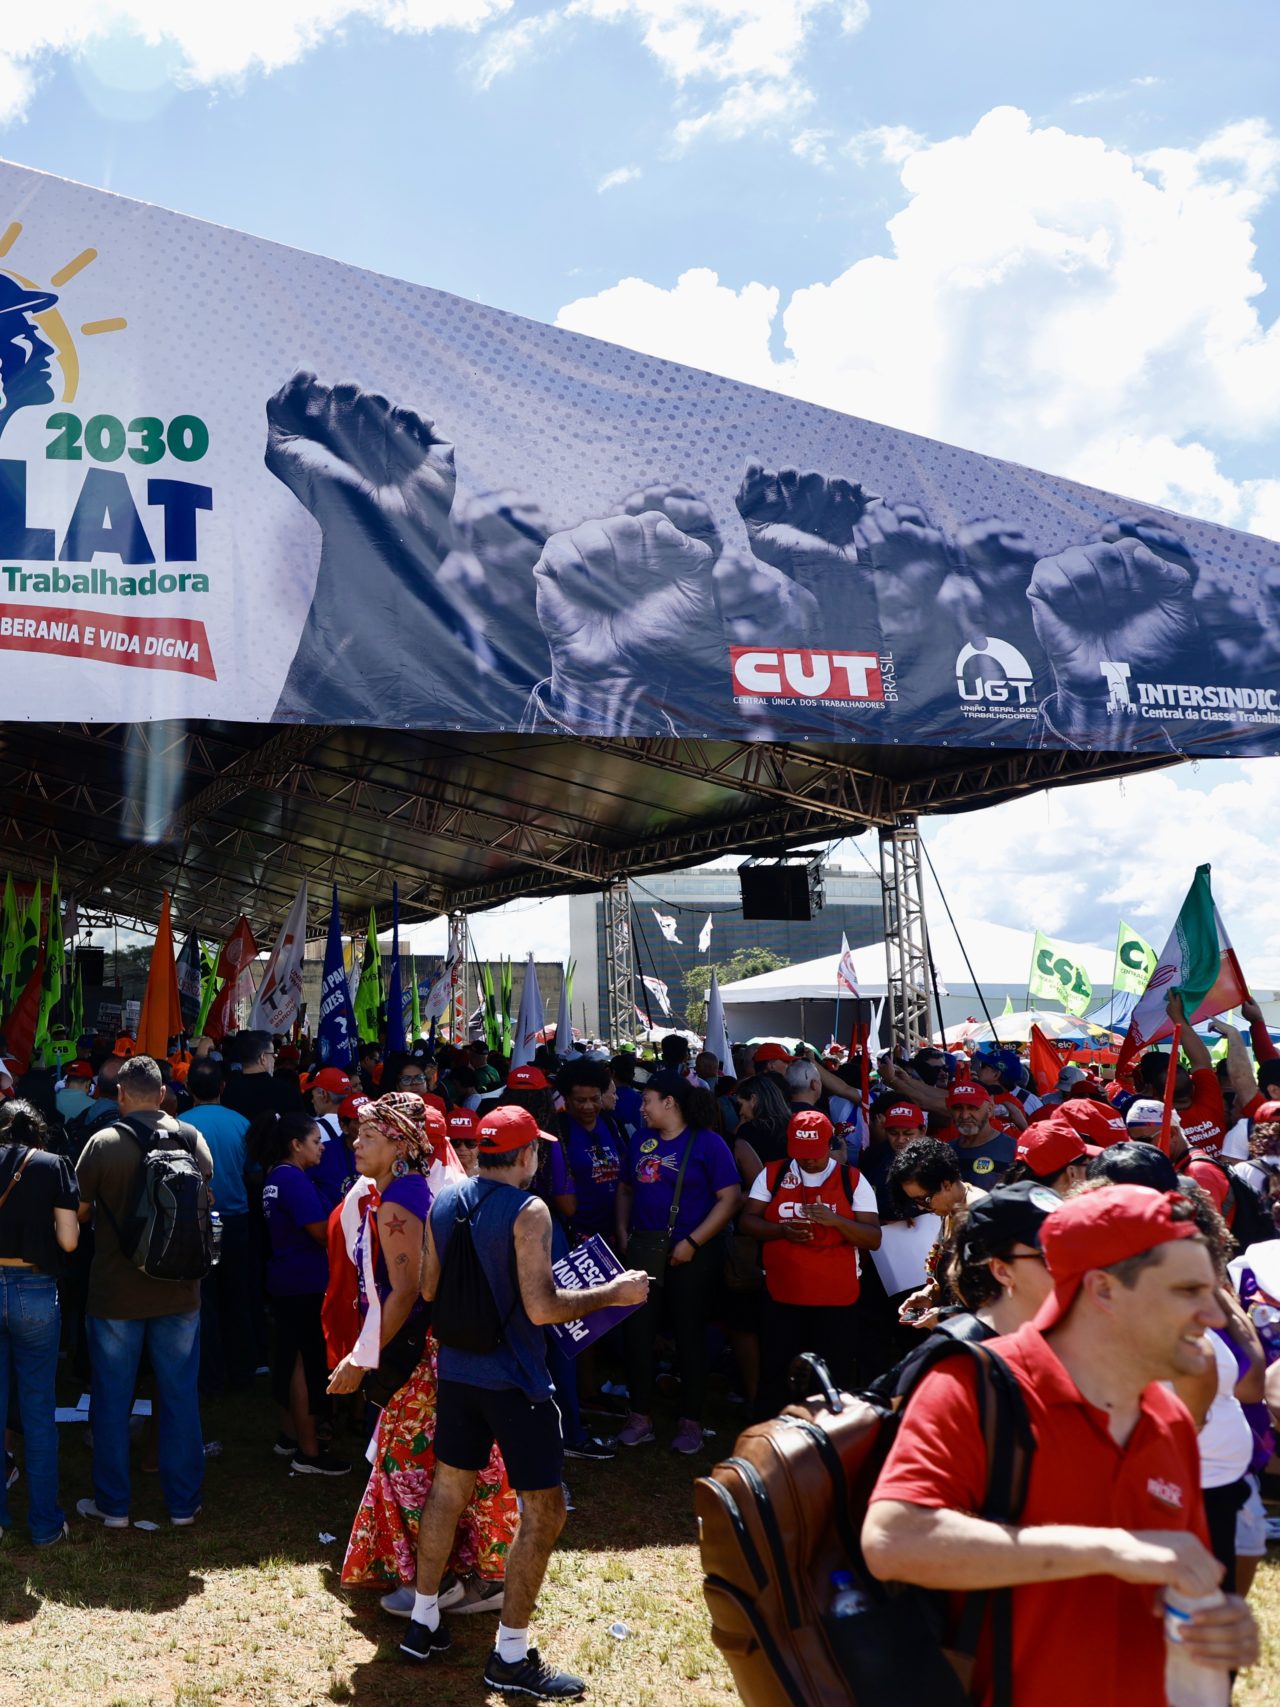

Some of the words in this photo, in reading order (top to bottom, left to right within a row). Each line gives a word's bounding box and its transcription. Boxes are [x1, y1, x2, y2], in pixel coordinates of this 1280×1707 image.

[45, 412, 209, 464] 2030
[2, 566, 210, 596] Trabalhadora
[83, 627, 96, 646] E
[99, 629, 141, 654] VIDA
[143, 637, 200, 662] DIGNA
[734, 652, 878, 697] CUT
[879, 652, 898, 702] BRASIL
[957, 677, 1034, 706] UGT
[1136, 683, 1280, 711] INTERSINDIC
[733, 696, 769, 705] CENTRAL
[771, 696, 797, 706] ÚNICA
[800, 699, 817, 707] DOS
[821, 700, 886, 710] TRABALHADORES
[960, 704, 987, 712] UNIÃO
[963, 712, 1037, 720] TRABALHADORES
[1141, 706, 1183, 719] Central
[1185, 708, 1199, 720] da
[1201, 709, 1236, 722] Classe
[352, 1096, 369, 1106] CUT
[890, 1107, 911, 1116] CUT
[481, 1127, 498, 1136] CUT
[796, 1130, 816, 1138] CUT
